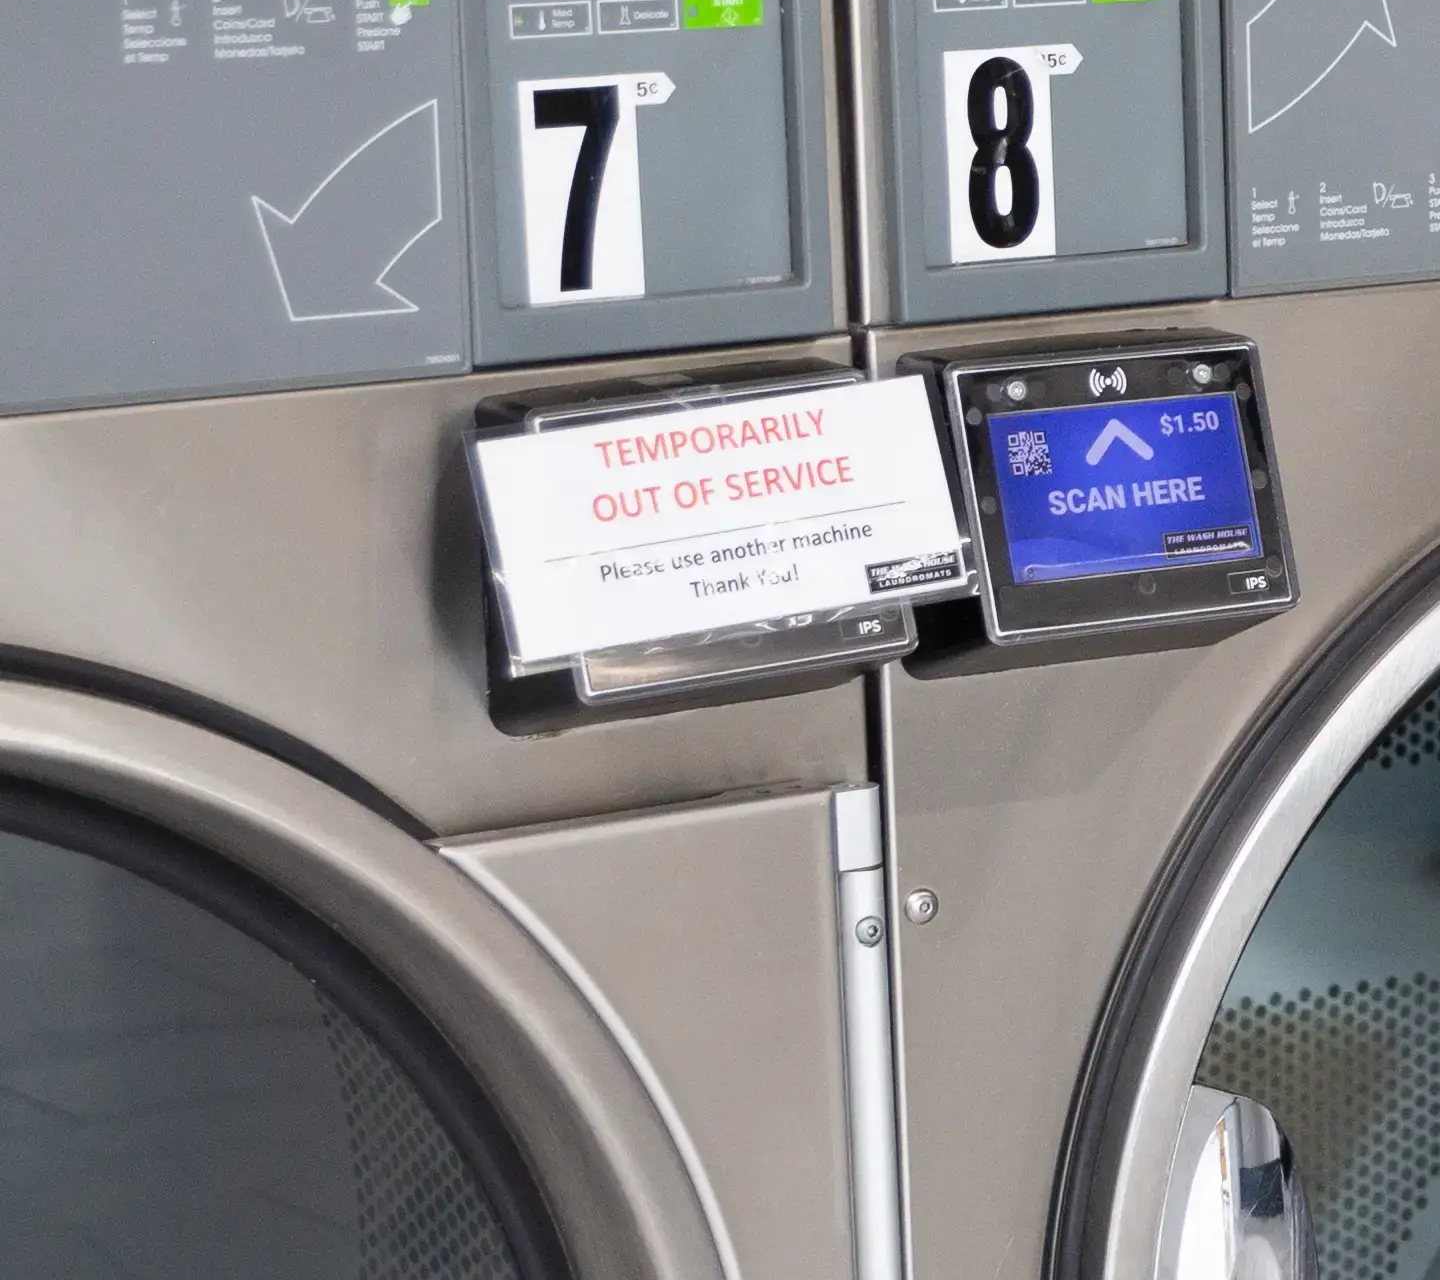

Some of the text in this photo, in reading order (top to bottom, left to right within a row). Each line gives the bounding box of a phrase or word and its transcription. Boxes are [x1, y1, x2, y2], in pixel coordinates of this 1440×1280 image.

[967, 57, 1040, 249] 8
[533, 84, 620, 292] 7
[1319, 204, 1367, 217] Coins/Card
[594, 409, 824, 469] TEMPORARILY
[1160, 410, 1220, 437] $1.50
[592, 455, 854, 522] OUT OF SERVICE
[1048, 476, 1206, 516] SCAN HERE
[600, 522, 873, 583] Please use another machine
[1167, 527, 1248, 545] THE WASH HOUSE
[689, 564, 800, 599] Thank You!
[879, 569, 952, 588] LAUNDROMATS
[1245, 576, 1266, 590] IPS
[859, 620, 881, 635] IPS
